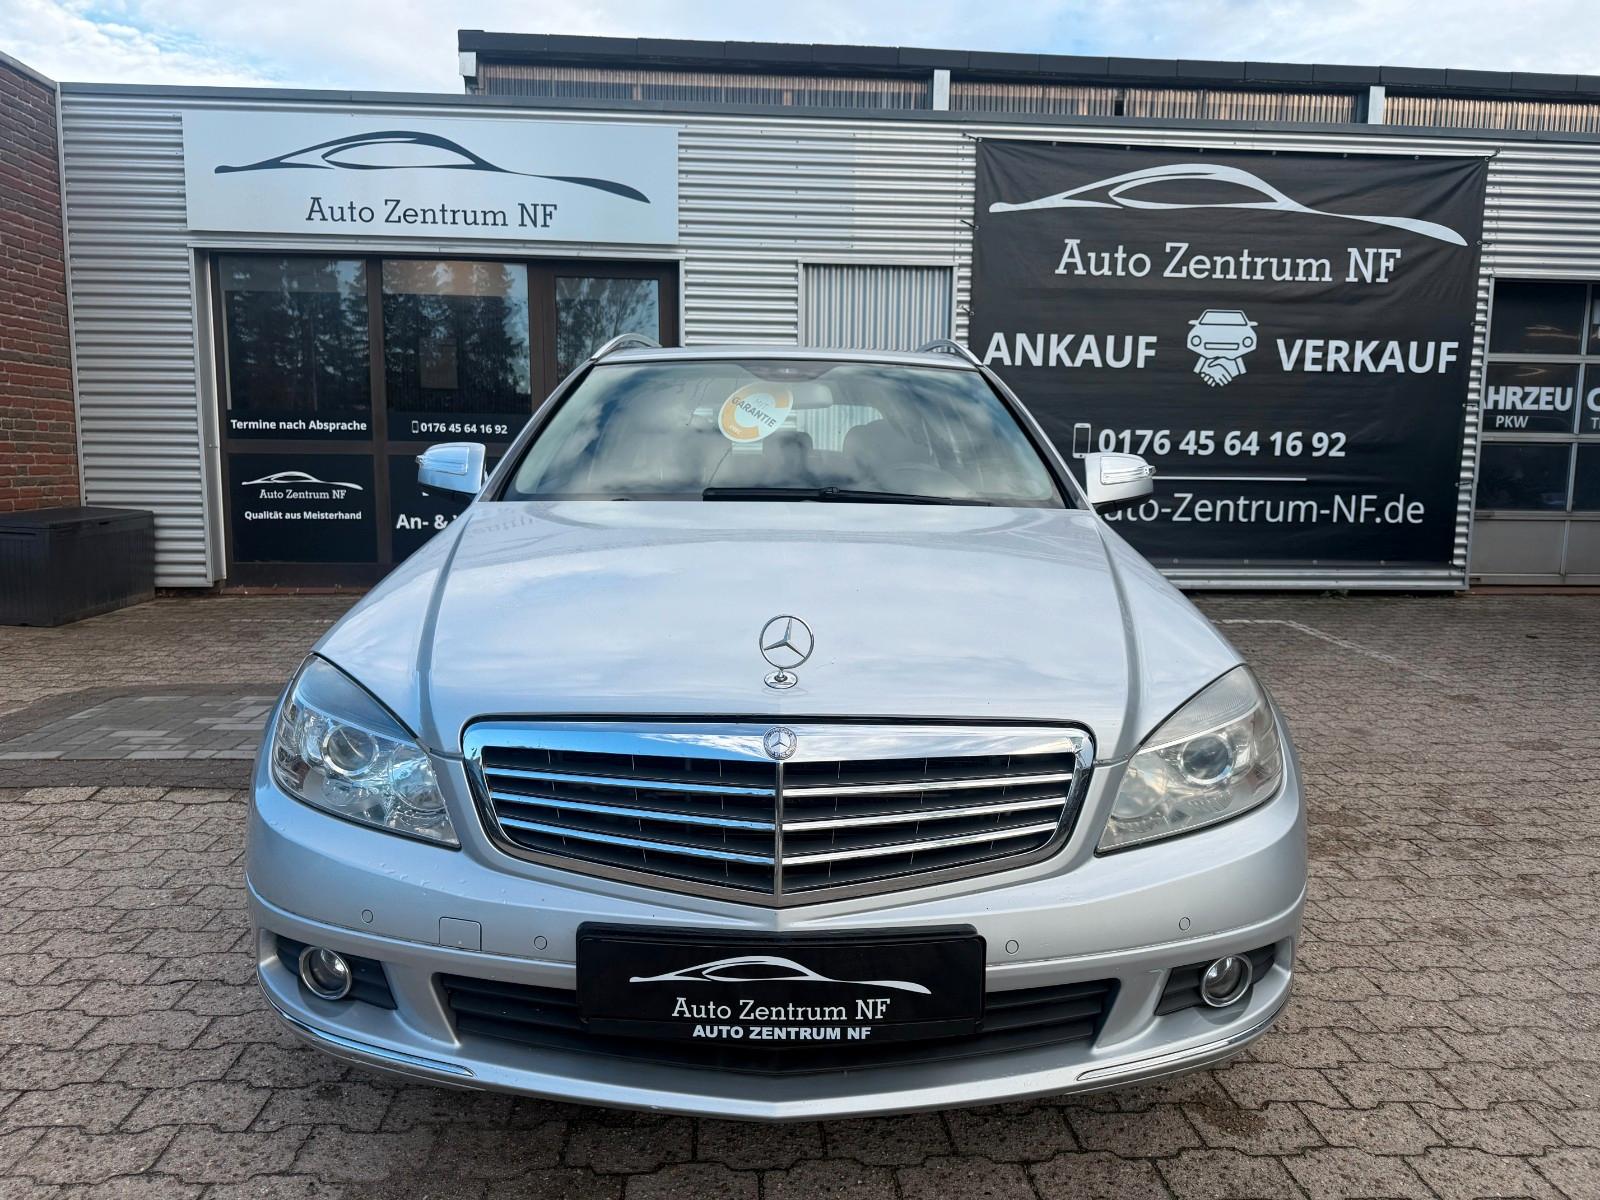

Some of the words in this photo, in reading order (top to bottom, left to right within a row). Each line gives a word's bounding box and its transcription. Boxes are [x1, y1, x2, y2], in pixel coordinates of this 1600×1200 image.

[306, 197, 375, 224] Auto
[385, 199, 508, 227] Zentrum
[518, 203, 558, 228] NF
[1055, 239, 1152, 278] Auto
[1163, 242, 1334, 283] Zentrum
[1346, 248, 1402, 284] NF
[984, 331, 1158, 370] ANKAUF
[1277, 338, 1459, 374] VERKAUF
[732, 397, 776, 428] GARANTIE
[230, 419, 276, 430] Termine
[279, 419, 306, 430] nach
[308, 419, 367, 433] Absprache
[420, 422, 447, 433] 0176
[448, 423, 462, 433] 45
[463, 423, 477, 434] 64
[480, 424, 493, 434] 16
[495, 424, 508, 435] 92
[1495, 415, 1529, 429] PKW
[1098, 428, 1171, 456] 0176
[1179, 429, 1215, 456] 45
[1224, 430, 1260, 456] 64
[1270, 431, 1303, 457] 16
[1312, 431, 1347, 457] 92
[259, 488, 284, 499] Auto
[286, 488, 330, 499] Zentrum
[332, 488, 347, 500] NF
[244, 510, 283, 521] Qualität
[285, 511, 302, 521] aus
[303, 510, 362, 521] Meisterhand
[396, 513, 429, 530] An-
[433, 514, 449, 530] &
[672, 997, 731, 1020] Auto
[740, 1000, 848, 1021] Zentrum
[856, 998, 891, 1020] NF
[693, 1025, 744, 1039] AUTO
[749, 1027, 841, 1040] ZENTRUM
[848, 1027, 872, 1040] NF
